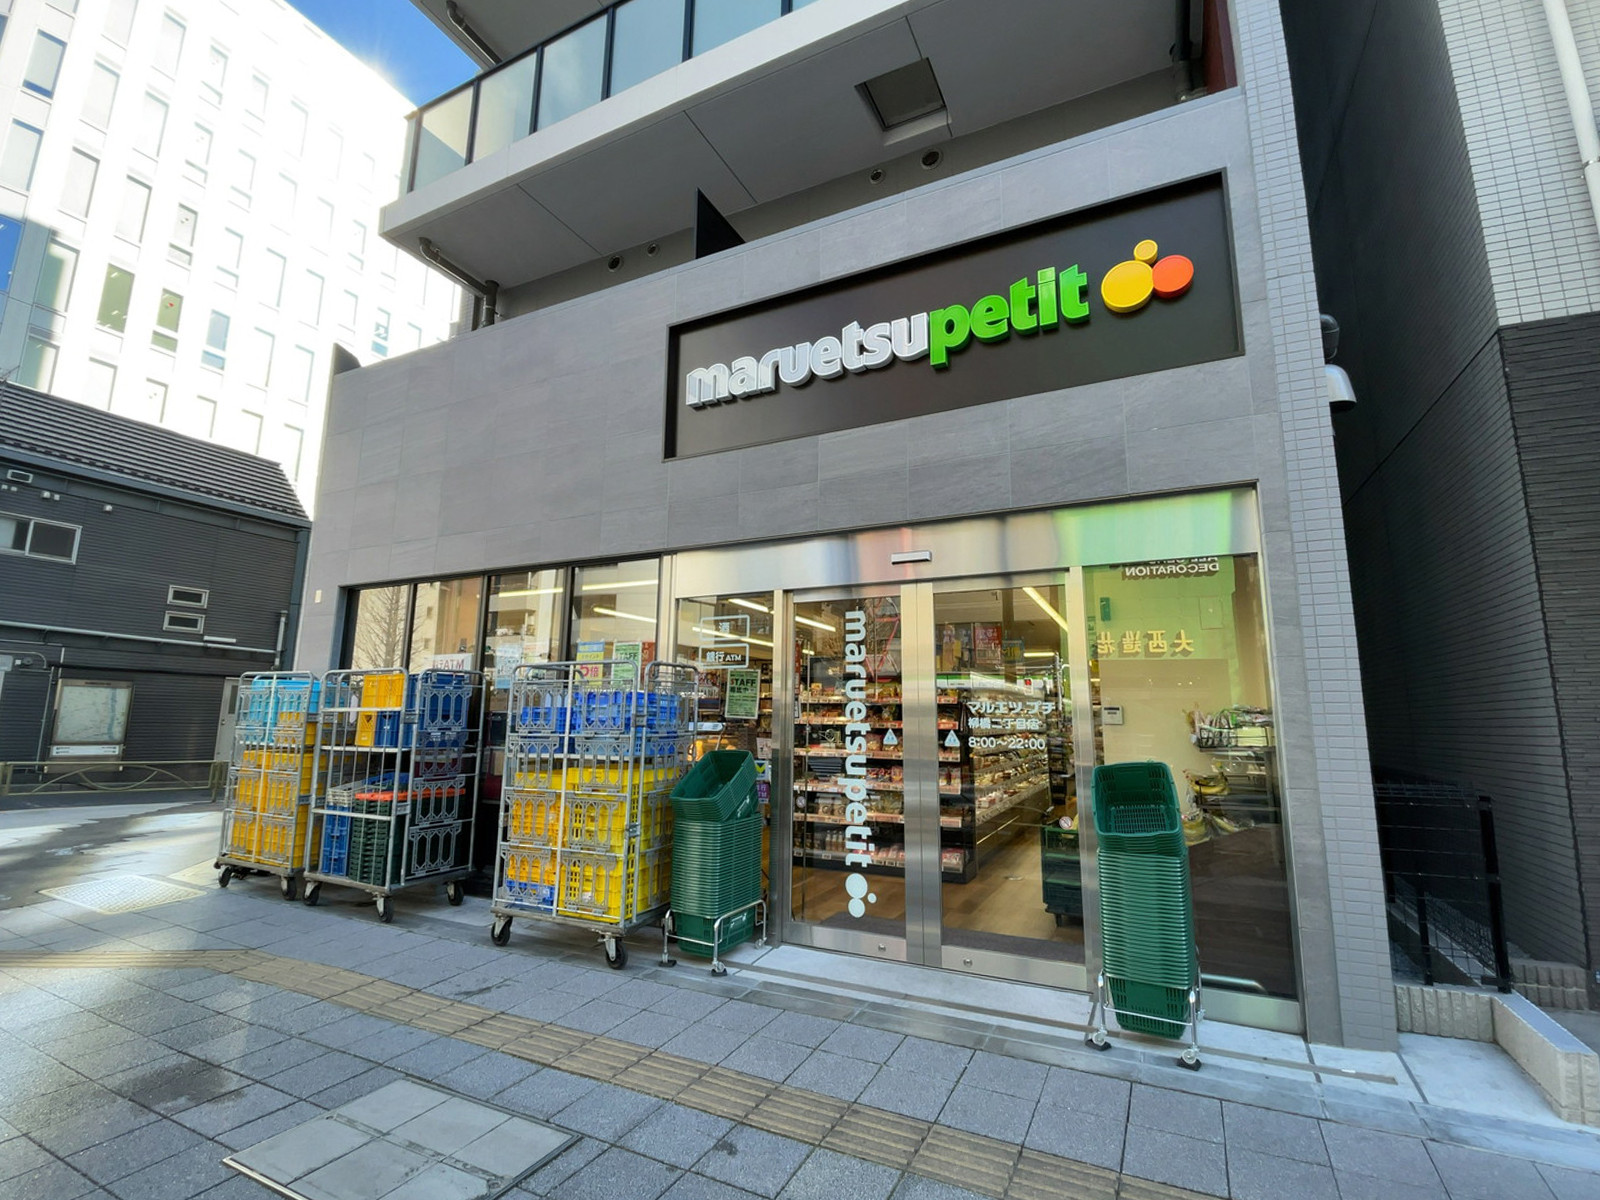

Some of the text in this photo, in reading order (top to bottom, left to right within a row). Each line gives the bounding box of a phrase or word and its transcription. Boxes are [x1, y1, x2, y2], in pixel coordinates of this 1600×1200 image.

[725, 653, 742, 662] ATM
[730, 678, 757, 687] STAFF
[966, 700, 1056, 714] マルエツ プチ
